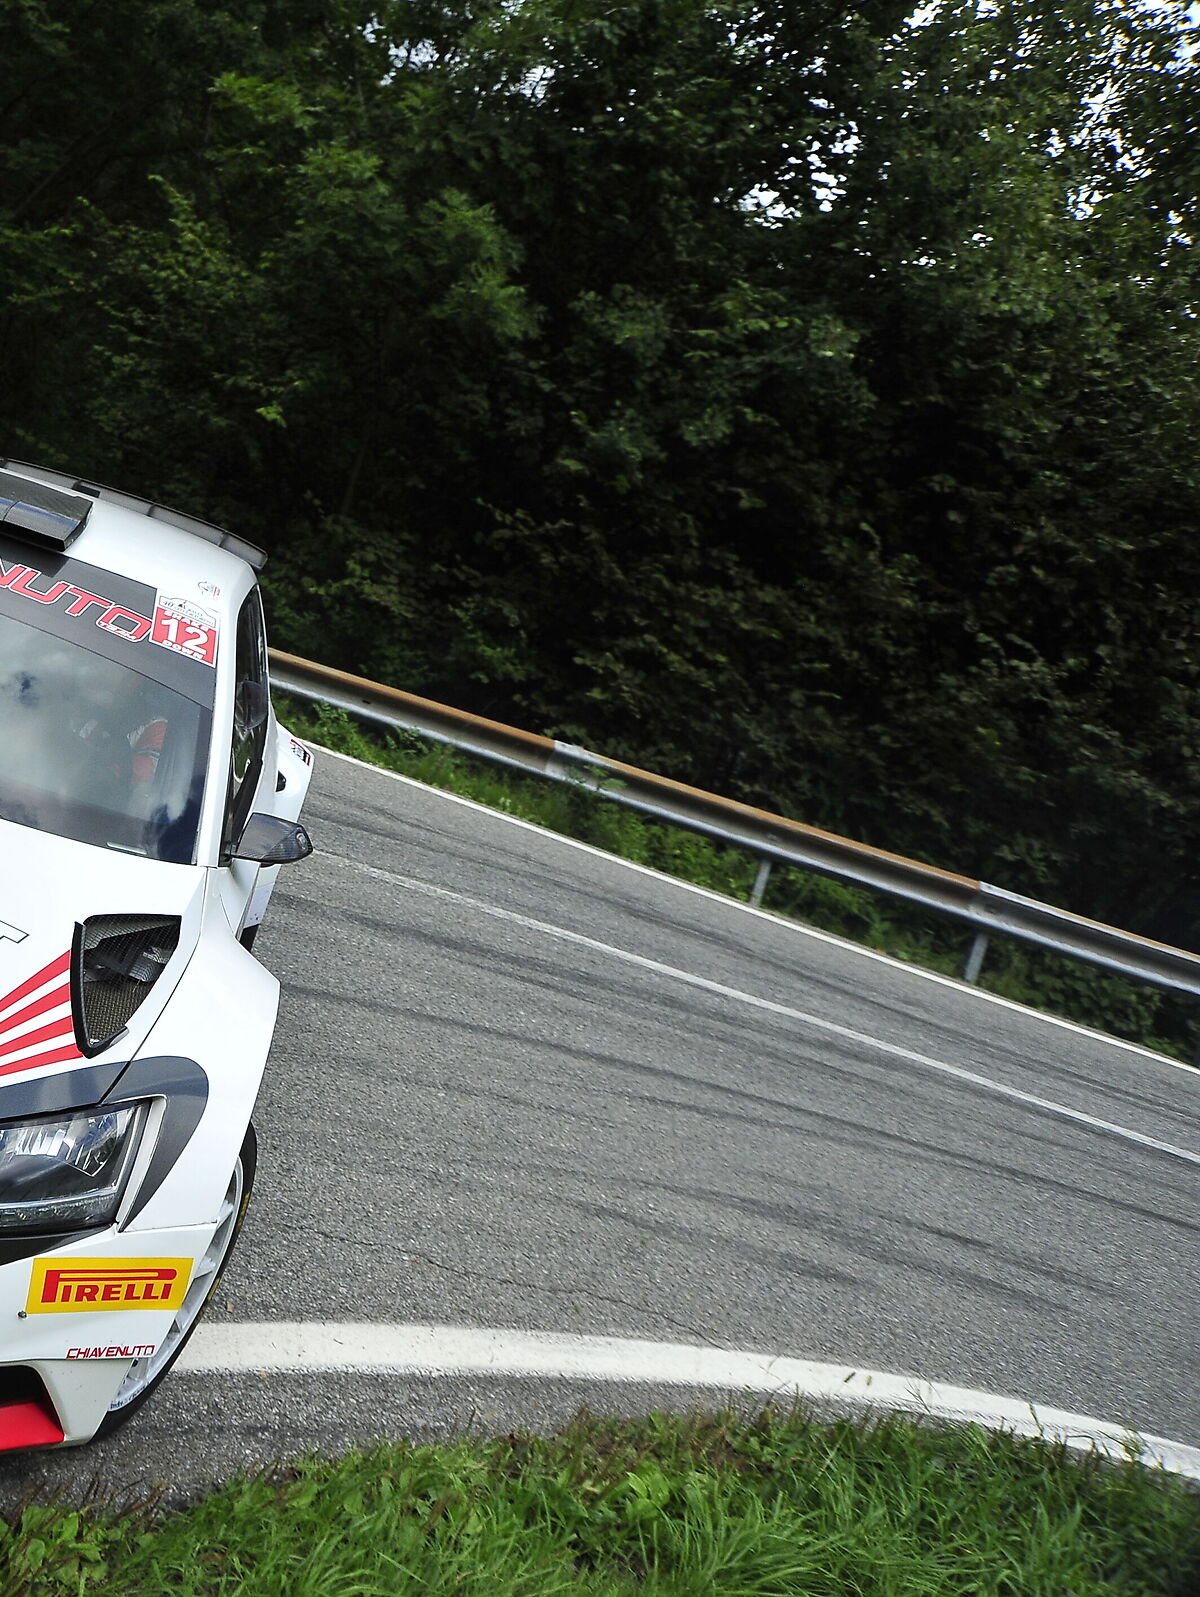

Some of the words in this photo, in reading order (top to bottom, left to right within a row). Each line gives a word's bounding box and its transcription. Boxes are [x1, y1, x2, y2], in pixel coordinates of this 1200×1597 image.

[160, 618, 209, 656] 12
[161, 639, 205, 661] DOWN
[41, 1268, 178, 1304] PIRELLI
[66, 1345, 156, 1359] CHIAVENUTO
